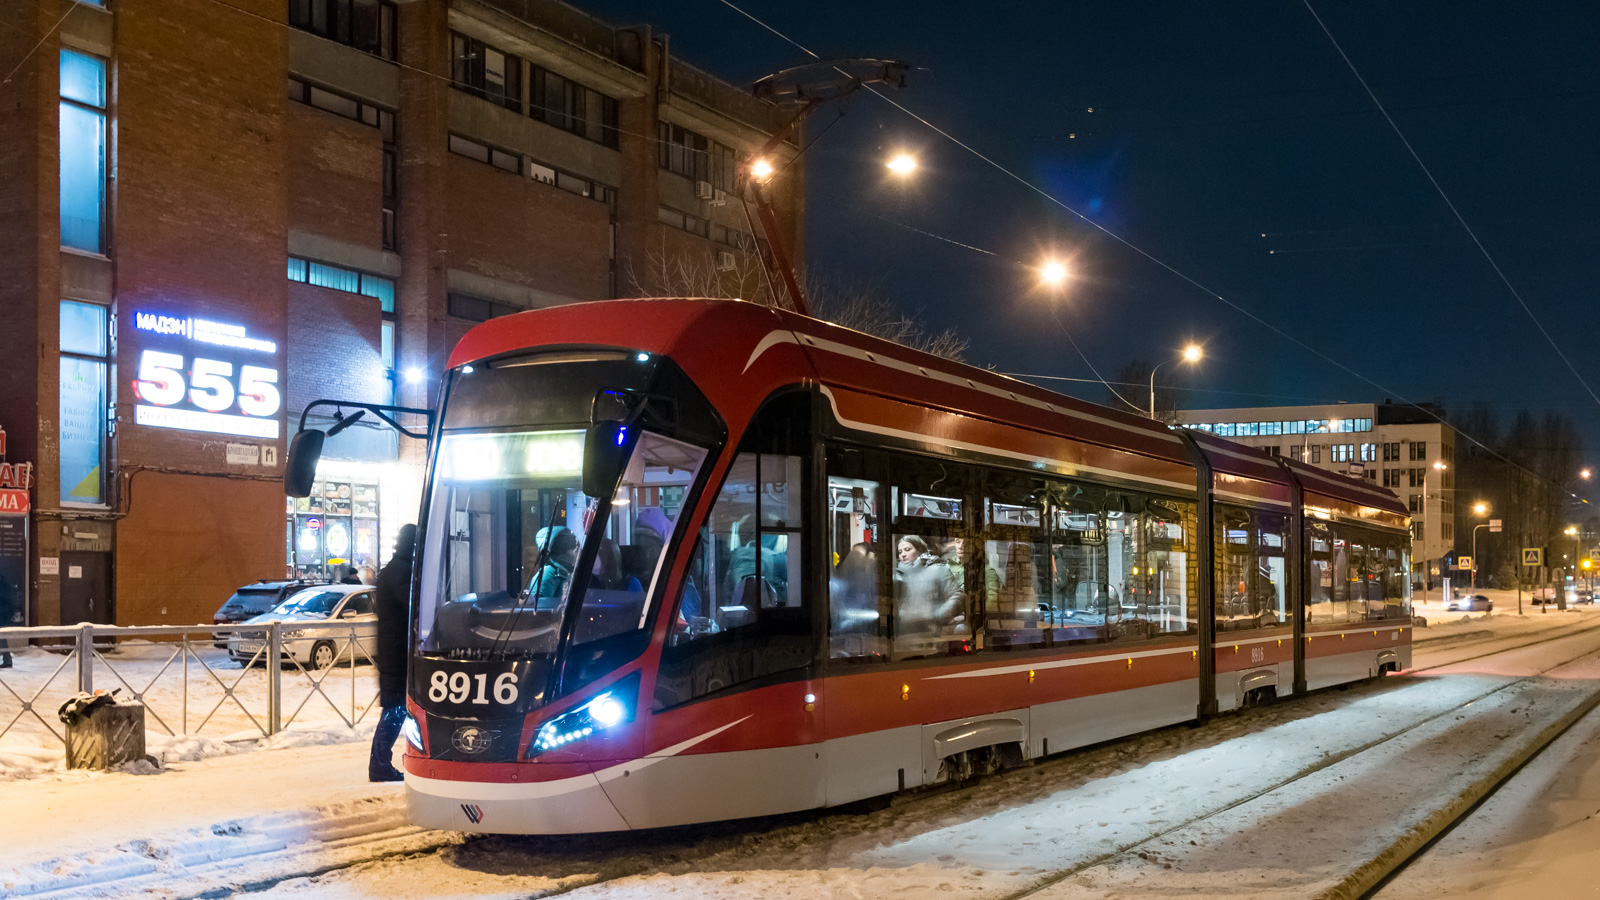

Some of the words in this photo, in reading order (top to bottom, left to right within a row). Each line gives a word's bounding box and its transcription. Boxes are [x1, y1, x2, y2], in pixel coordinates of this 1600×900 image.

[136, 312, 186, 335] МАДЭН
[137, 350, 280, 417] 555
[1251, 647, 1264, 663] 8916
[428, 670, 519, 705] 8916
